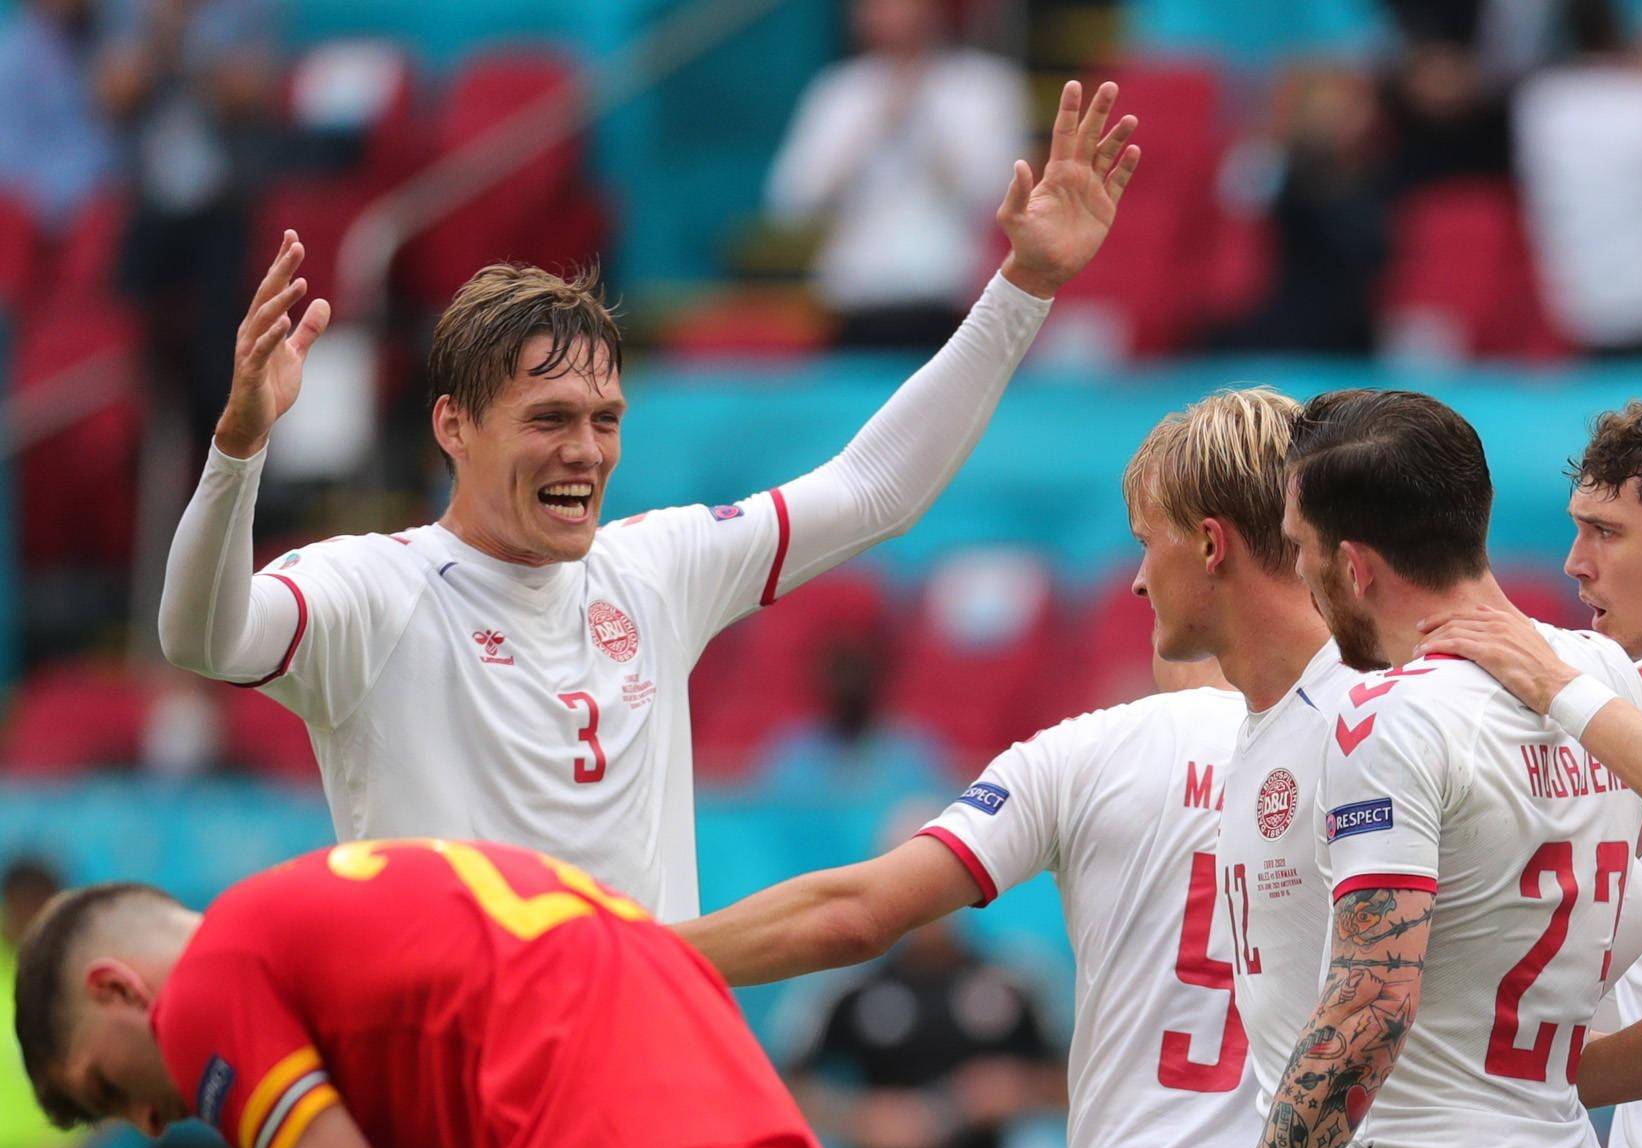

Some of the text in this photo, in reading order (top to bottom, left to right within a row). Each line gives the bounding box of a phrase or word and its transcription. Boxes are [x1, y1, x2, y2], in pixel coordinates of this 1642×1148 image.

[558, 692, 605, 783] 3
[1264, 791, 1289, 815] DBU
[1336, 806, 1391, 831] RESPECT
[1158, 852, 1249, 1092] 5
